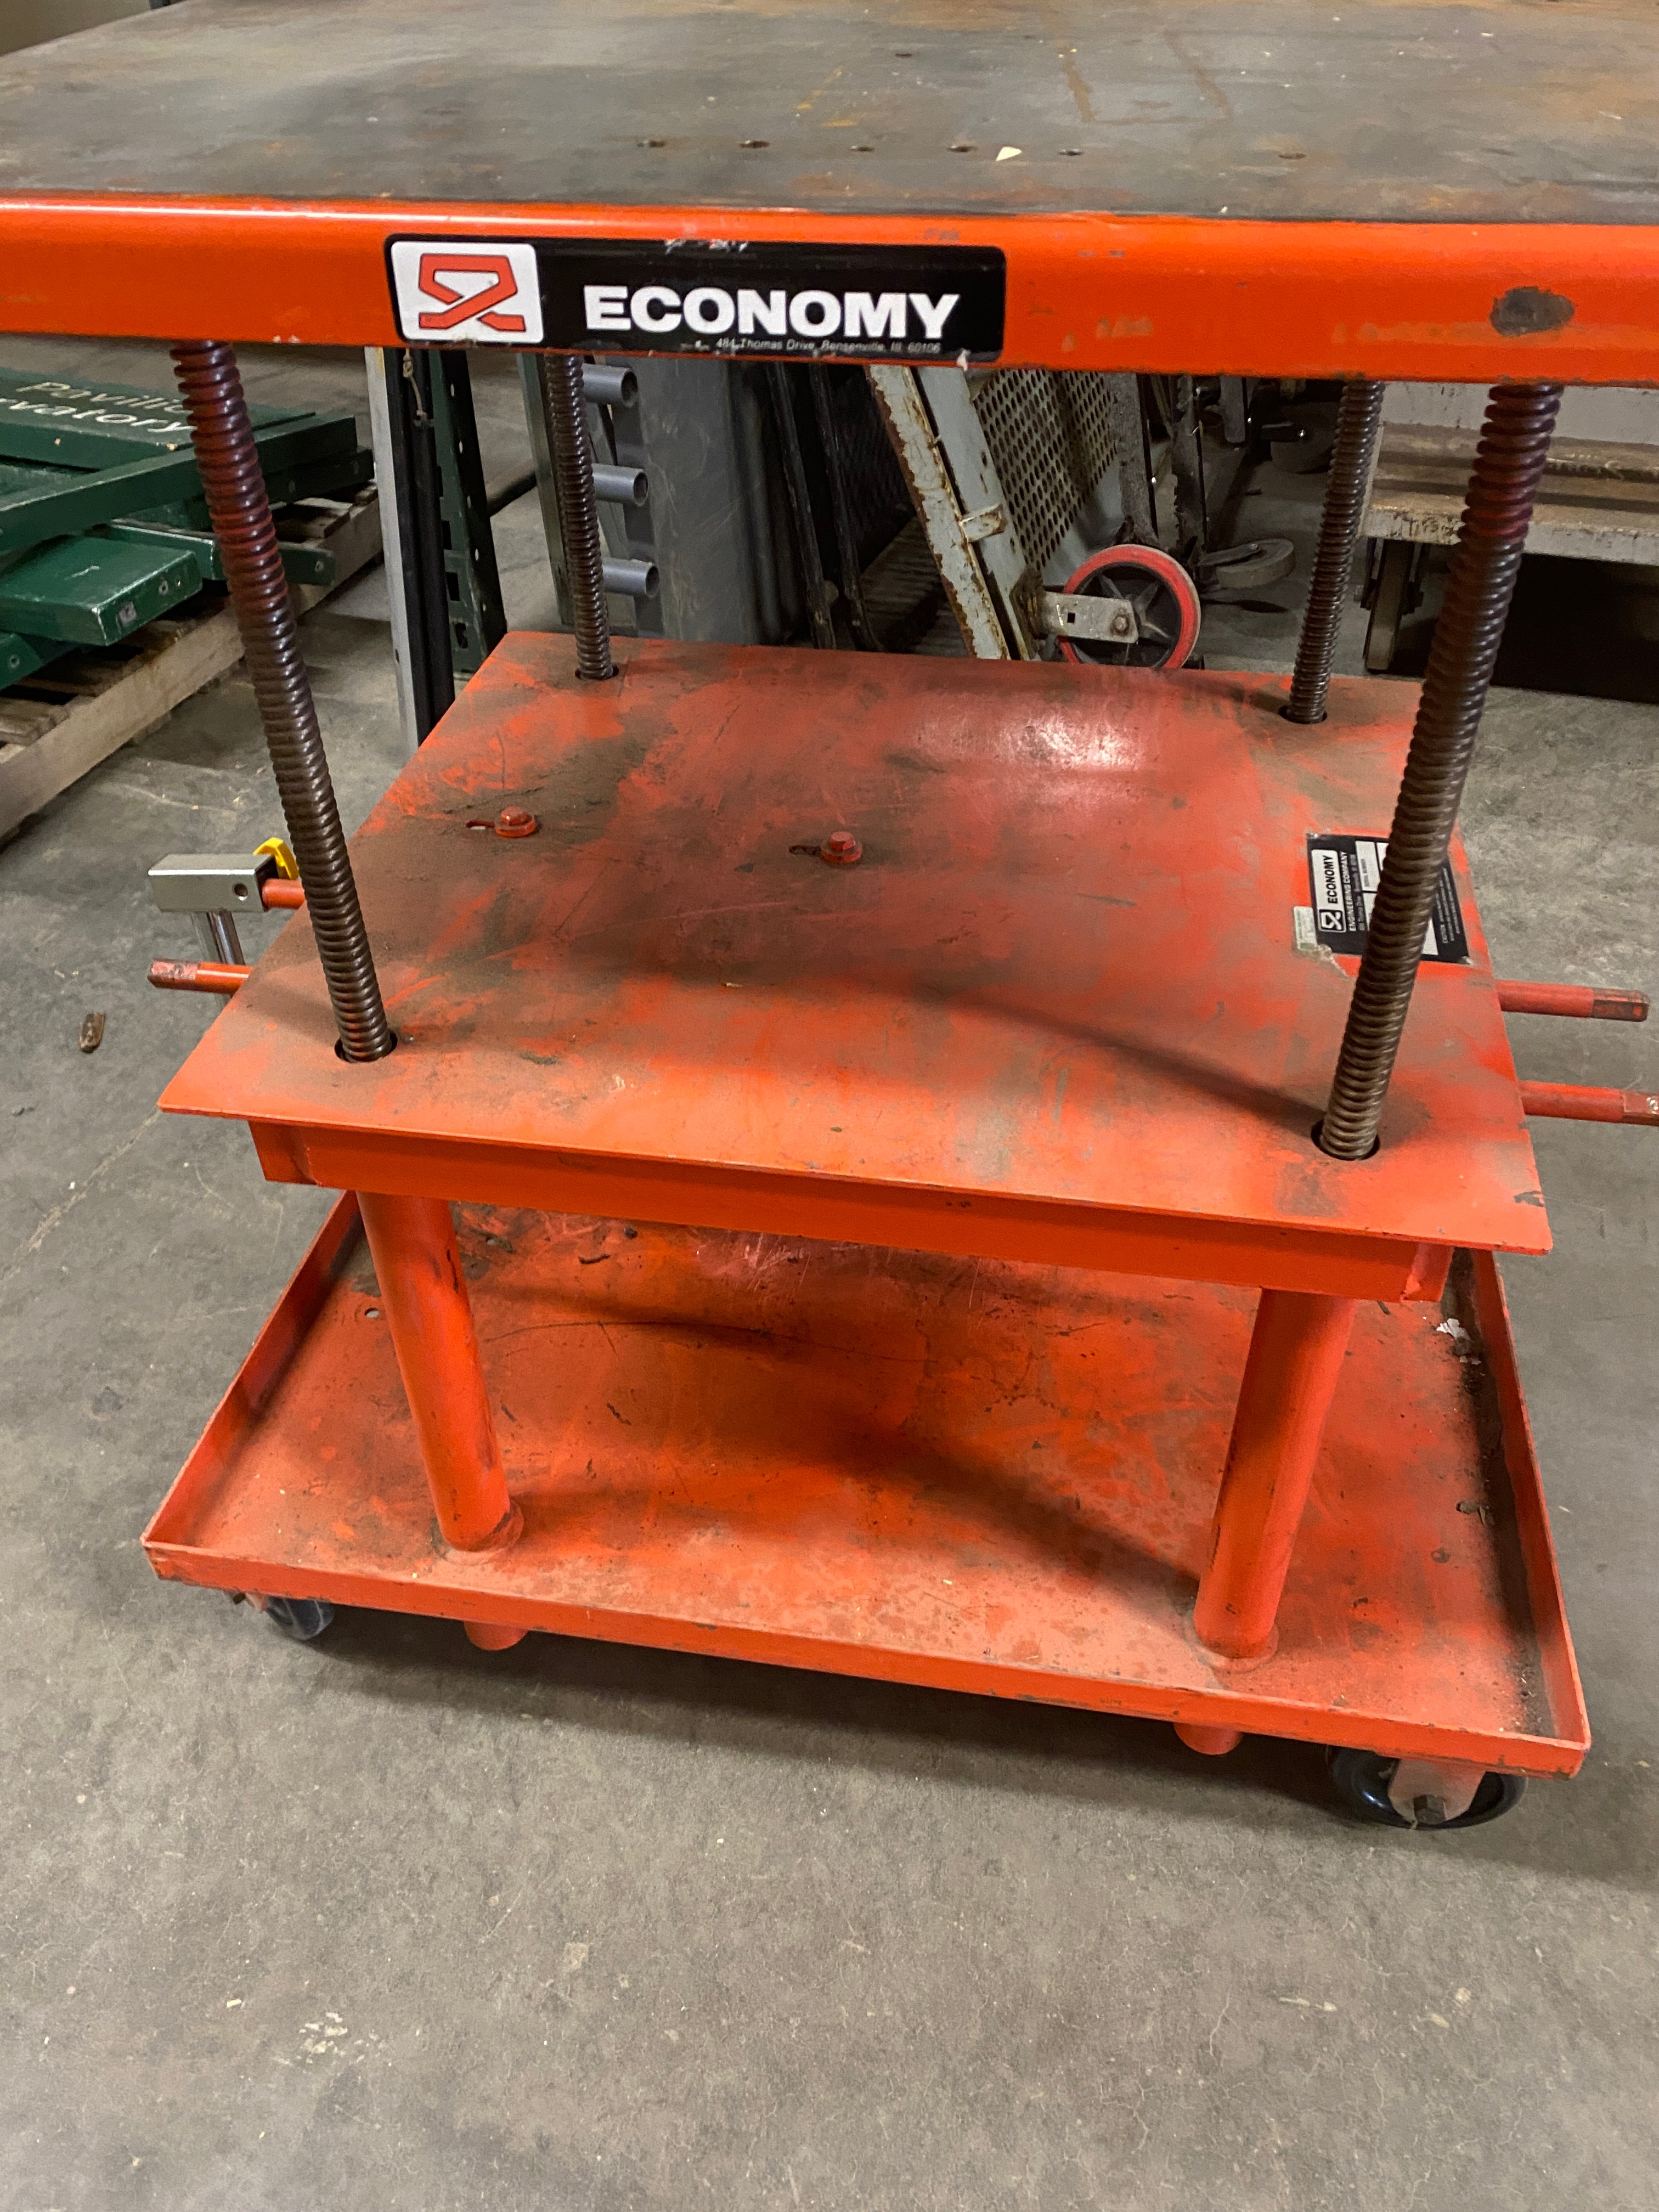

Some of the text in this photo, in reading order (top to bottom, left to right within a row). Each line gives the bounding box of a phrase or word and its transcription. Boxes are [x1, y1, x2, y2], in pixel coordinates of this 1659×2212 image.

[584, 285, 961, 339] ECONOMY
[15, 381, 194, 414] Pavilio
[1323, 855, 1338, 904] ECONOMY
[1340, 851, 1357, 932] ENGINEERING COMPANY
